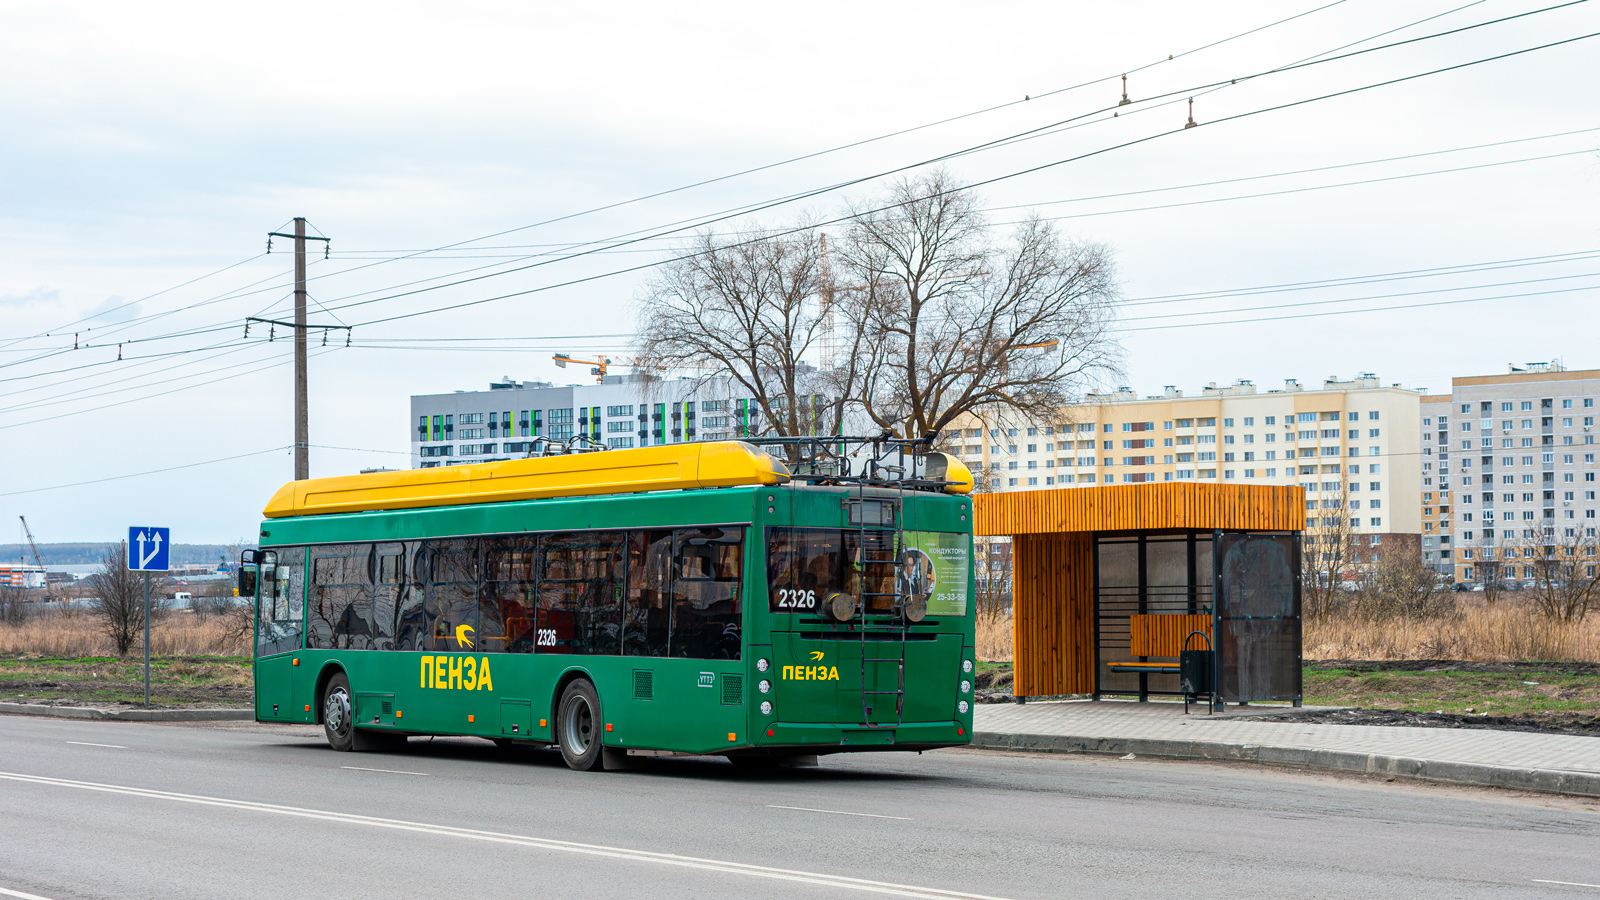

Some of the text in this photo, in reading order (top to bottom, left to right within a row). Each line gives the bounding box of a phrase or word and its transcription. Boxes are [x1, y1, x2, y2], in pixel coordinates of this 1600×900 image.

[928, 547, 967, 555] КОНДУКТОРЫ
[778, 588, 816, 609] 2326
[537, 628, 557, 647] 2326
[420, 655, 493, 692] ПЕНЗА
[782, 665, 840, 681] ПЕНЗА
